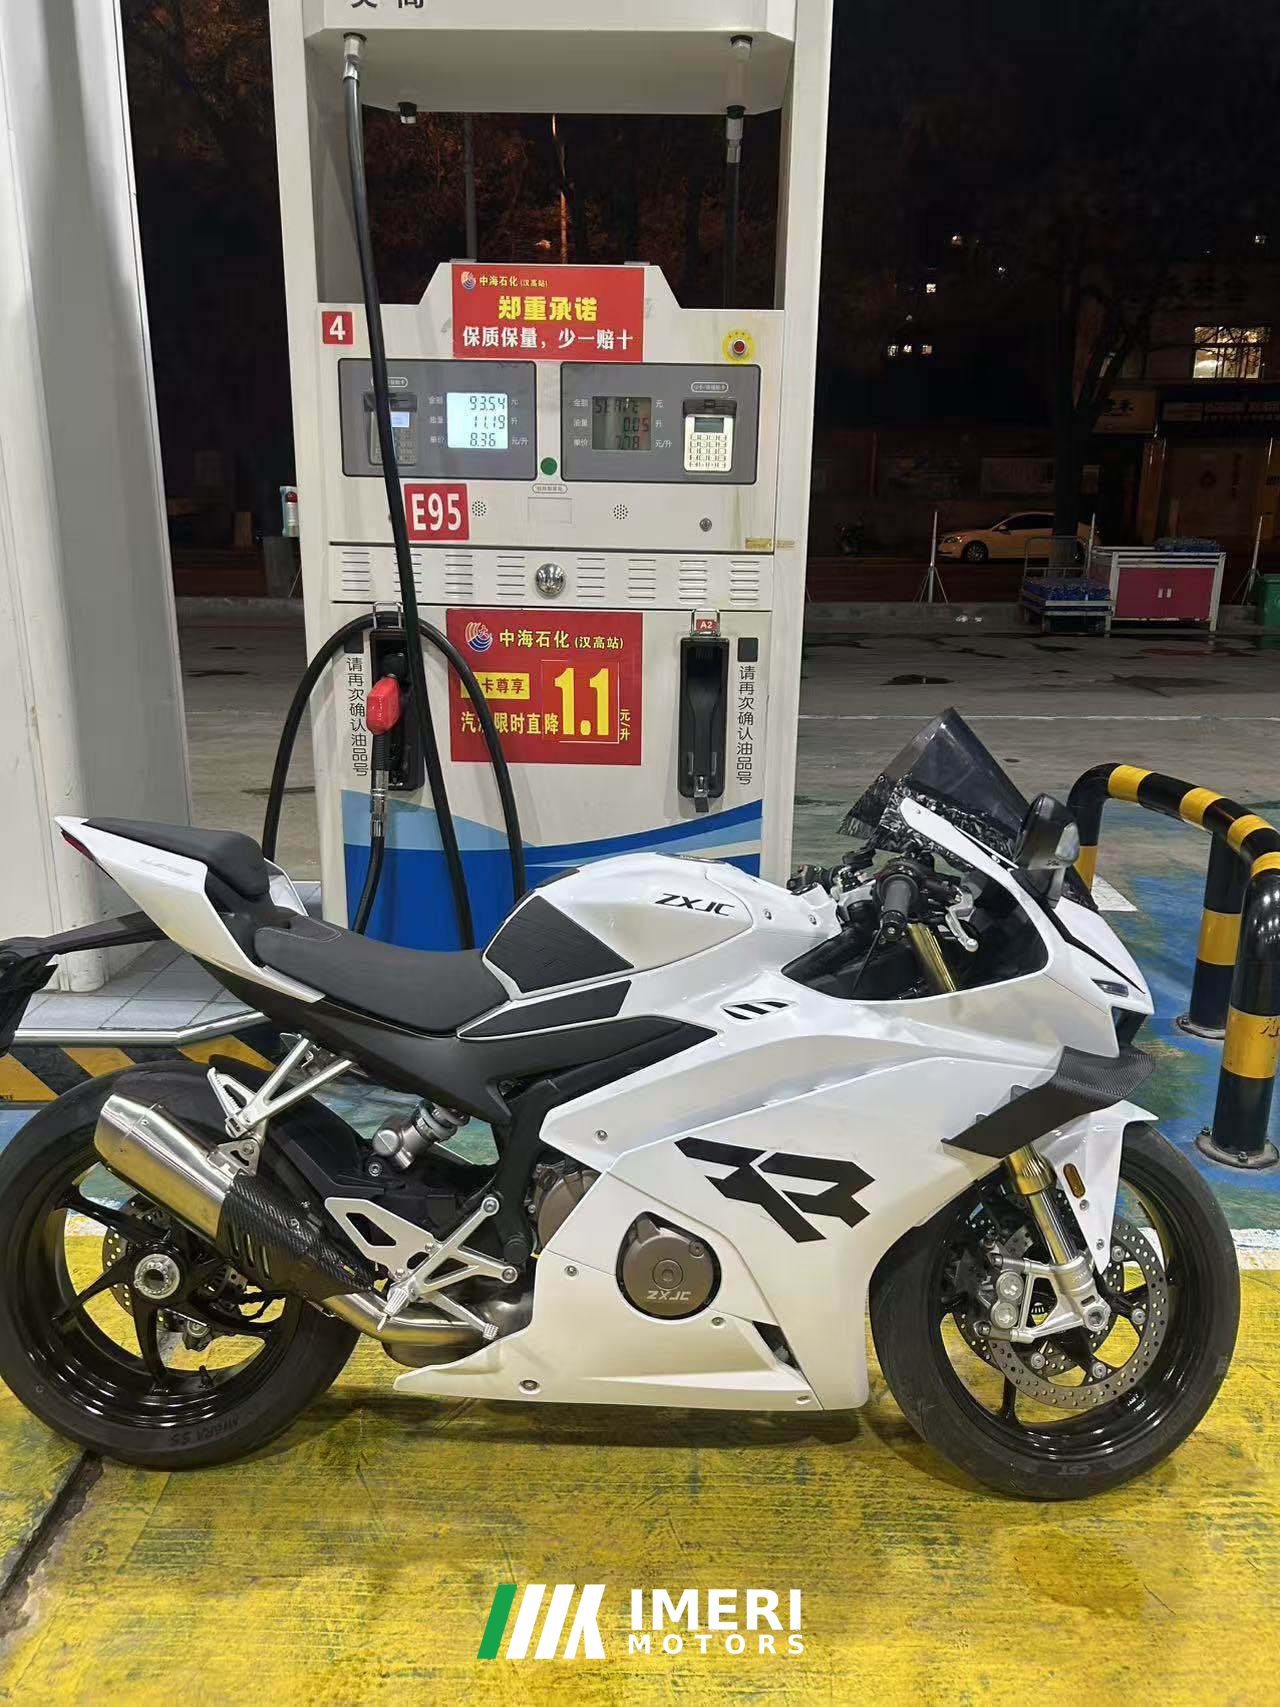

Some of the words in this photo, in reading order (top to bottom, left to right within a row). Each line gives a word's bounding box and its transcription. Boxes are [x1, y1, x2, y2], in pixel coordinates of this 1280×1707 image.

[479, 275, 518, 287] 中海石化
[498, 295, 598, 321] 郑重承诺
[329, 315, 346, 341] 4
[411, 492, 462, 532] E95
[699, 620, 713, 629] A2
[499, 629, 569, 648] 中海石化
[574, 636, 624, 650] (汉高站)
[476, 677, 525, 693] 卡尊享
[461, 710, 559, 736] 汽限时直降
[554, 667, 609, 736] 1.1
[346, 657, 369, 777] 请再次确认油品号
[736, 665, 756, 785] 请再次确认油品号
[654, 892, 735, 917] ZXJC
[646, 1290, 692, 1301] ZXJC
